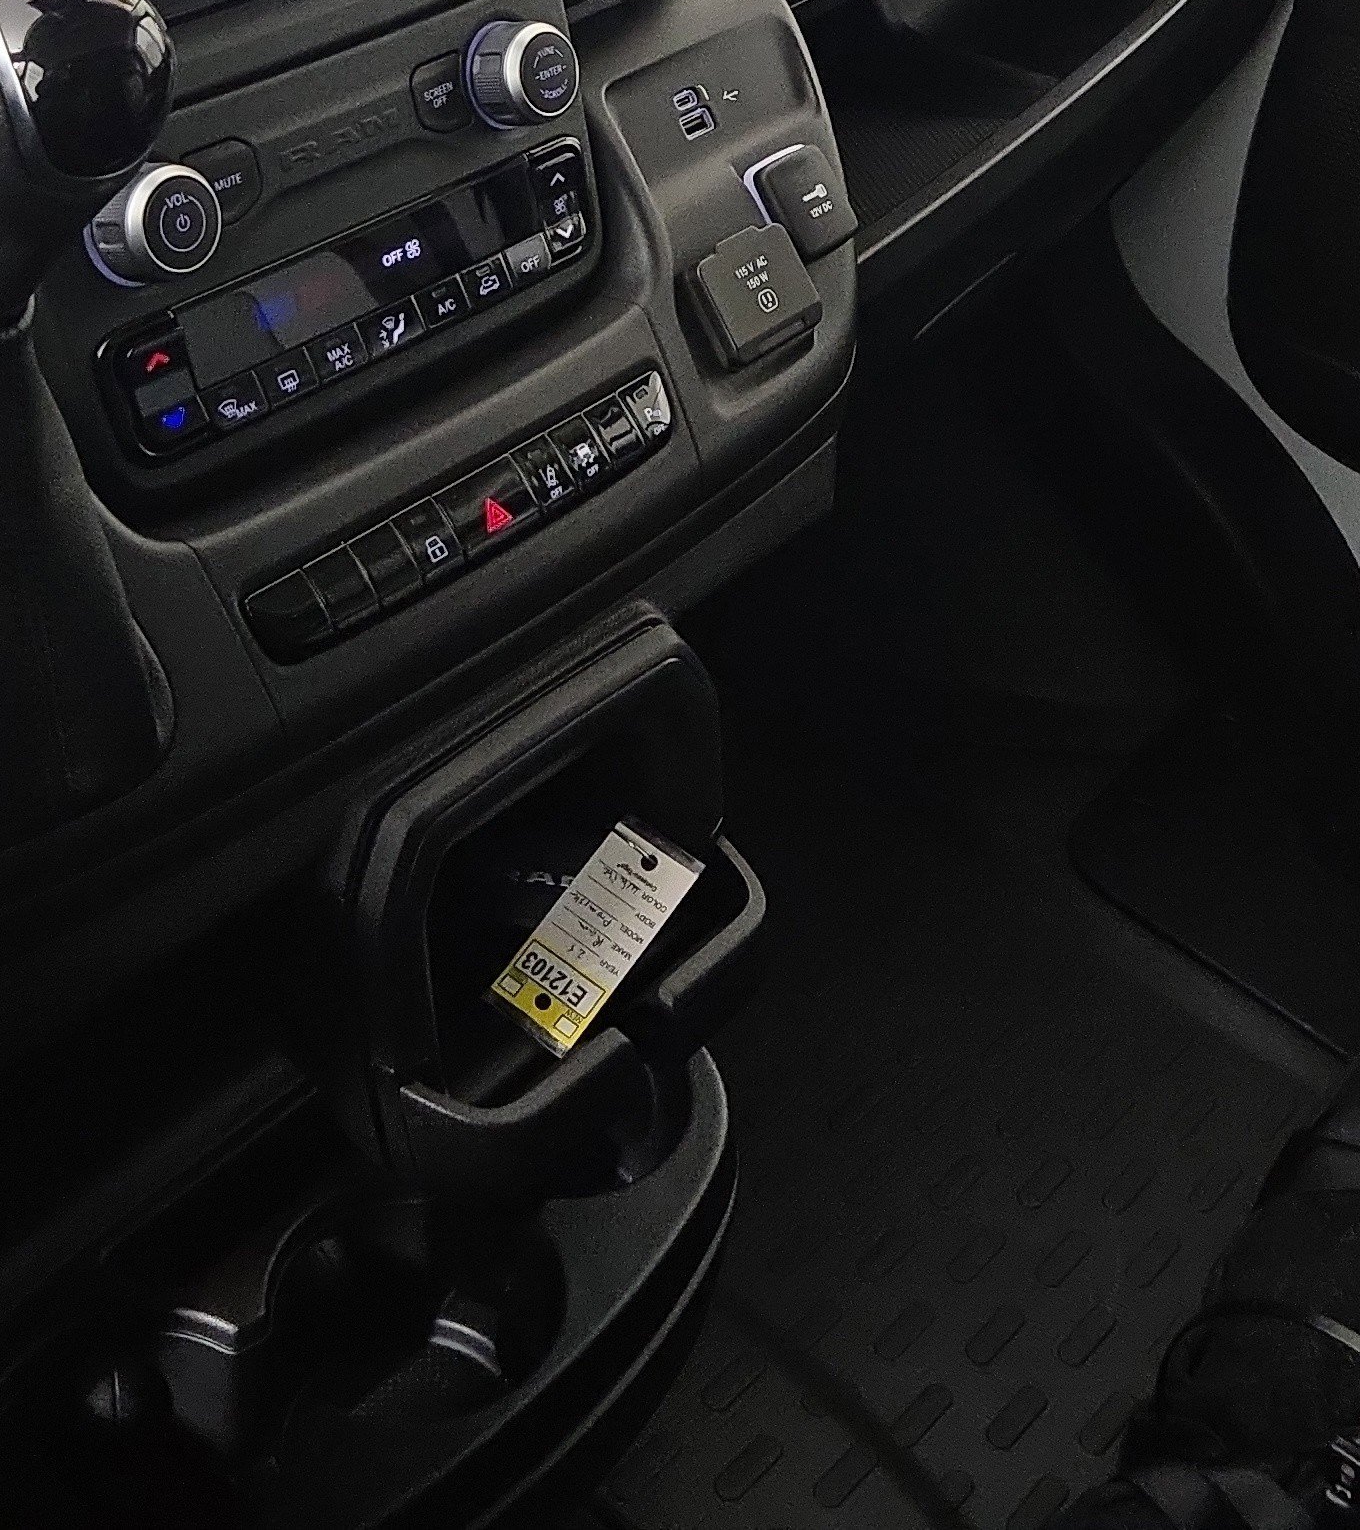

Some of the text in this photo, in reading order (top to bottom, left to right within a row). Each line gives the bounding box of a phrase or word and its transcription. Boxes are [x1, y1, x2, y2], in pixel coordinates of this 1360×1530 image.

[424, 82, 453, 101] SCREEN
[432, 96, 448, 109] OFF
[214, 172, 242, 191] MUTE
[165, 192, 189, 209] VOL
[382, 250, 404, 267] OFF
[520, 254, 540, 273] OFF
[756, 255, 768, 269] AC
[746, 277, 761, 290] 150
[437, 298, 457, 316] A/C
[326, 343, 351, 362] MAX
[334, 354, 353, 372] A/C
[235, 400, 258, 420] MAX
[640, 891, 667, 913] COLOR
[634, 910, 656, 929] BODY
[617, 922, 644, 944] MODEL
[610, 942, 632, 960] MAKE
[598, 958, 620, 977] YEAR
[519, 949, 588, 1007] E12103
